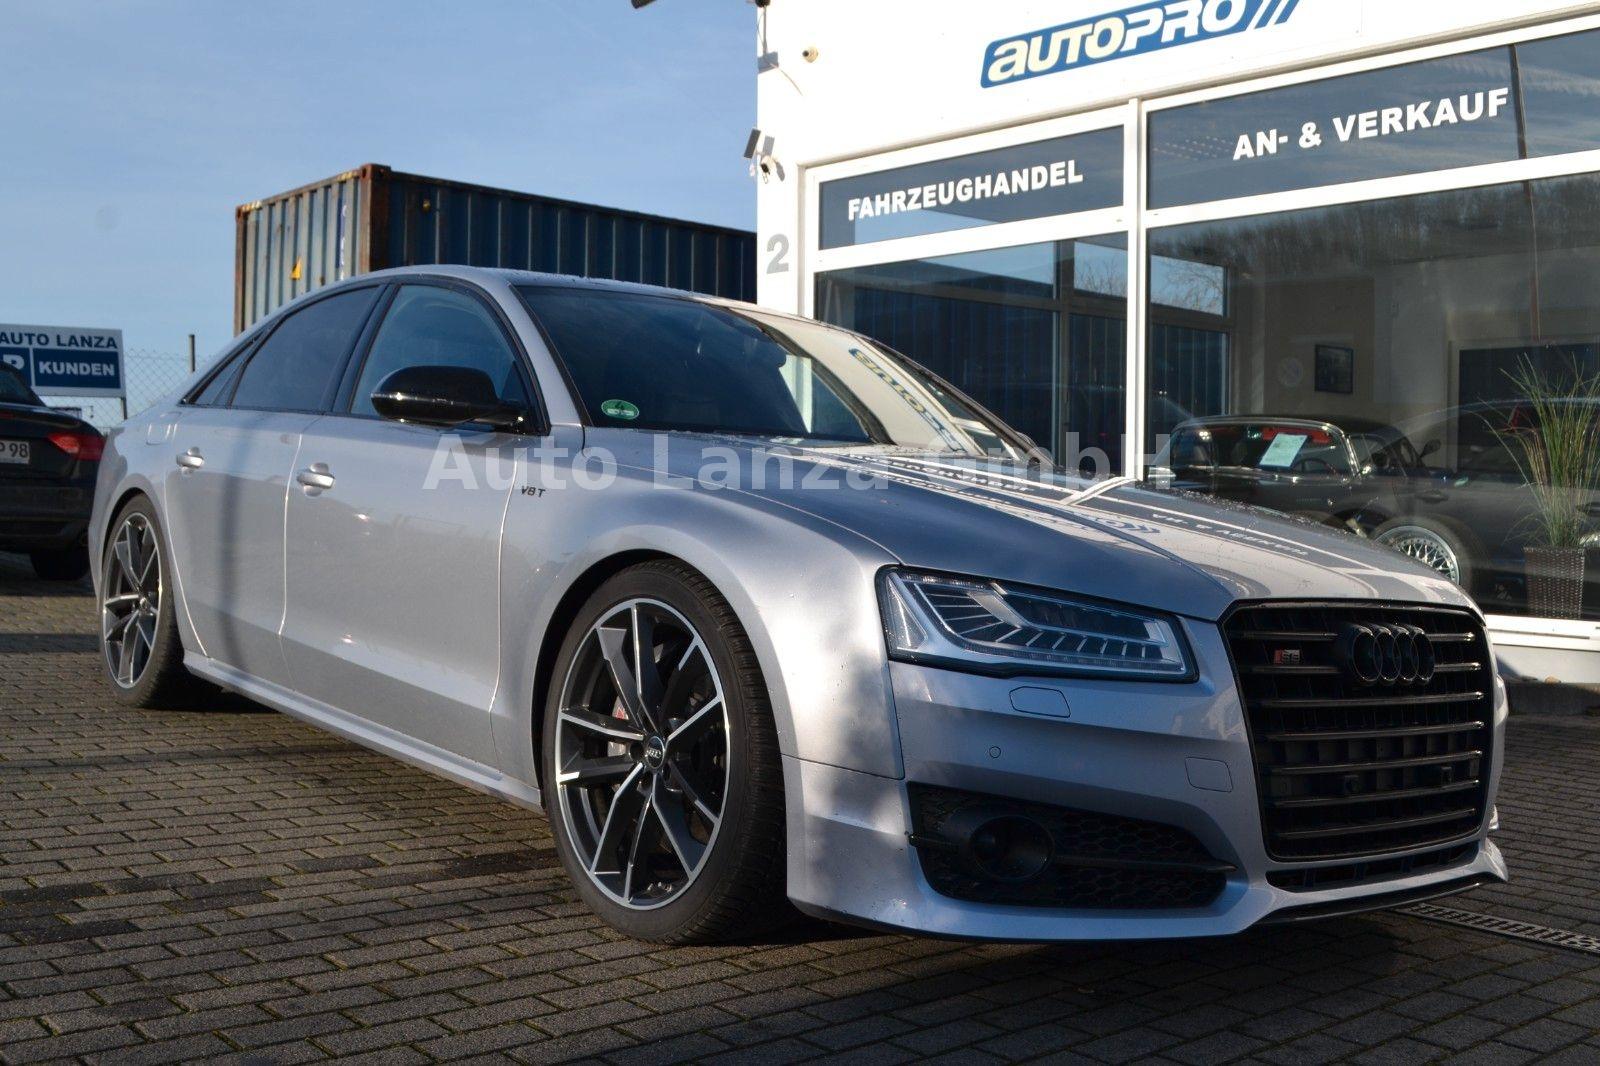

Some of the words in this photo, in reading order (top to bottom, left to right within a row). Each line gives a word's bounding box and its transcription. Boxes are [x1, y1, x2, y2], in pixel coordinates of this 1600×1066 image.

[1232, 128, 1289, 161] AN-
[1299, 121, 1322, 149] &
[1332, 87, 1509, 142] VERKAUF
[848, 160, 1083, 221] FAHRZEUGHANDEL
[766, 234, 790, 275] 2
[0, 331, 50, 347] AUTO
[56, 333, 118, 349] LANZA
[39, 361, 116, 377] KUNDEN
[9, 443, 28, 458] 98
